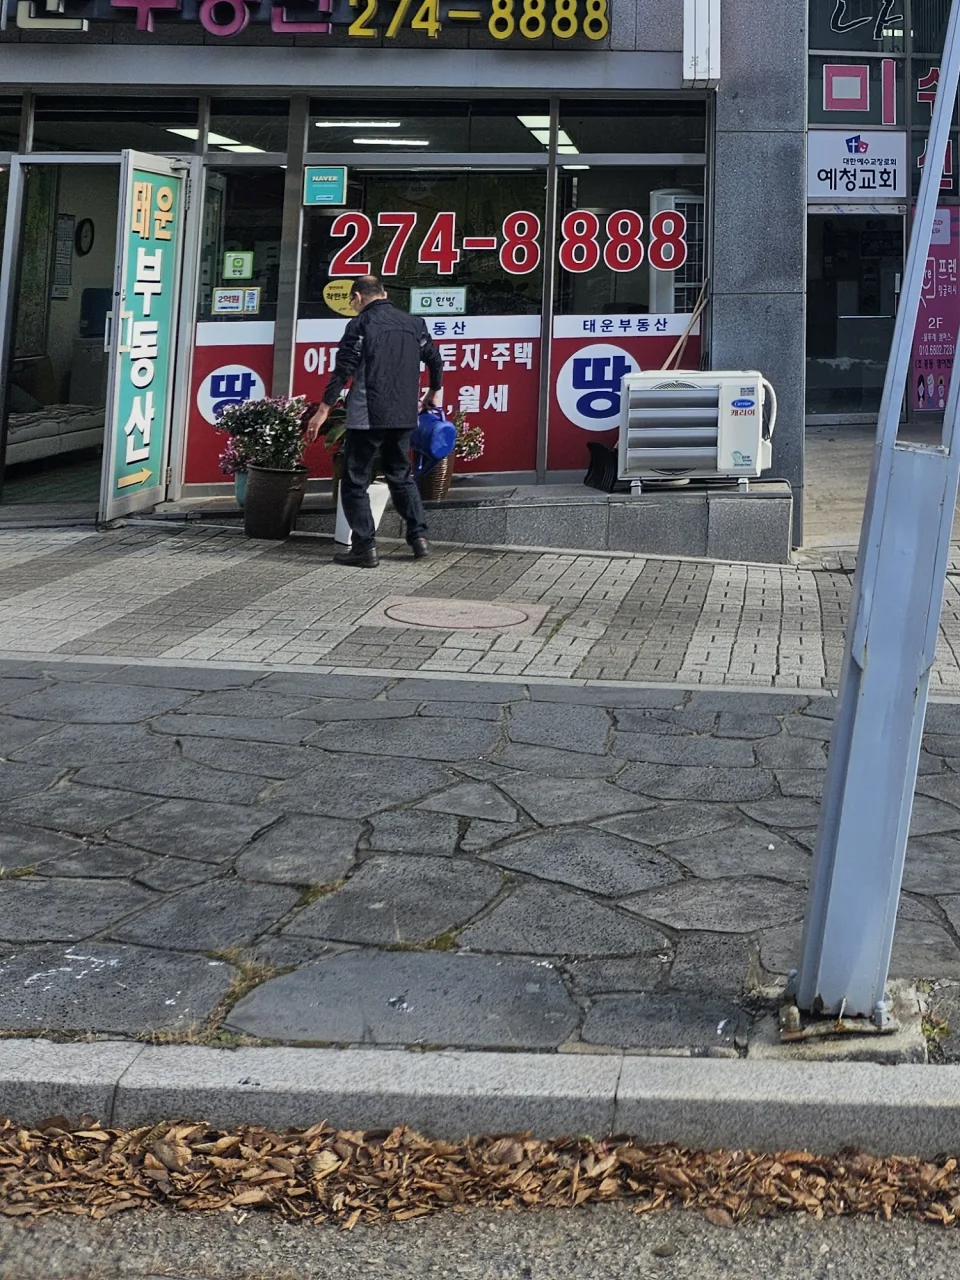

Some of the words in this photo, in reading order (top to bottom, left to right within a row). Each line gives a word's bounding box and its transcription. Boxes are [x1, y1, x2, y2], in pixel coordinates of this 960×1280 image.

[843, 158, 897, 166] 대한예수교장로회
[817, 168, 897, 191] 예청교회
[131, 181, 174, 240] 태운
[435, 296, 456, 308] 한방
[582, 318, 668, 333] 태운부동산
[928, 318, 943, 329] 2F
[124, 247, 162, 464] 부동산
[572, 356, 632, 419] 땅
